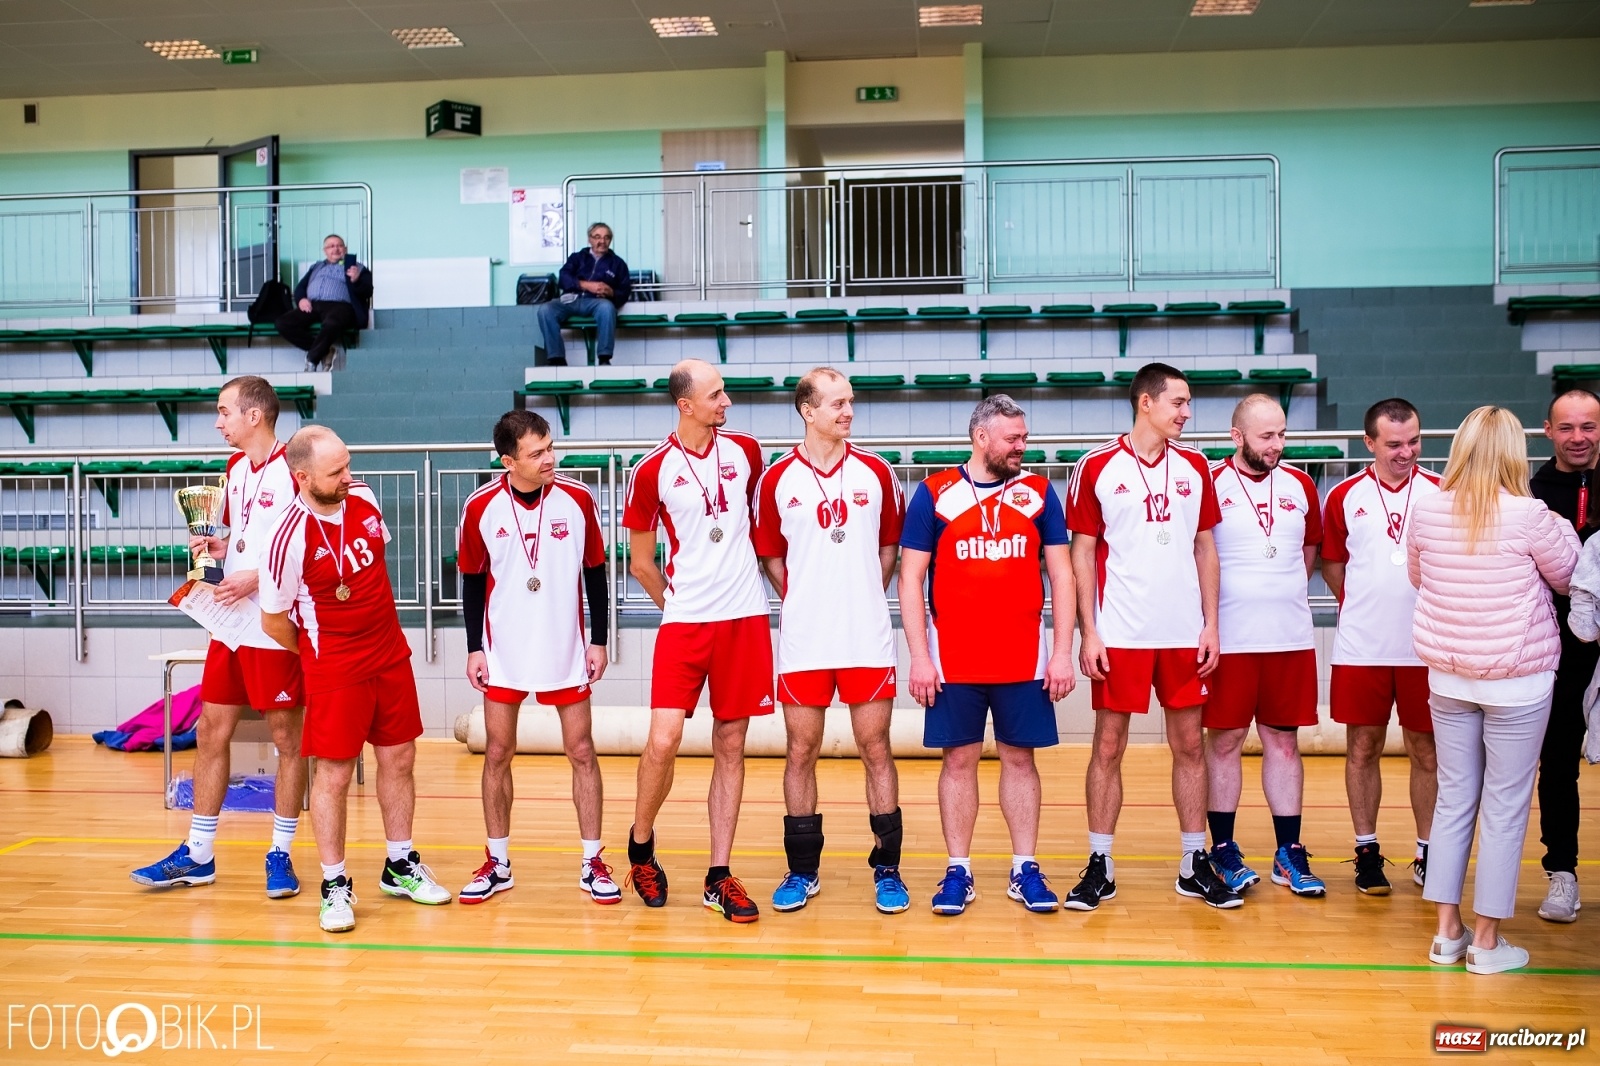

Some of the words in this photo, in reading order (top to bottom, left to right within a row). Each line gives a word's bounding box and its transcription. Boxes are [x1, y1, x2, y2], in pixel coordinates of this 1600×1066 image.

[430, 112, 439, 132] F
[454, 112, 471, 129] F
[702, 483, 729, 516] 14
[817, 498, 848, 529] 69
[1143, 494, 1171, 522] 12
[1256, 502, 1275, 529] 5
[1387, 512, 1402, 540] 8
[343, 537, 374, 574] 13
[524, 533, 539, 562] 7
[955, 533, 1027, 560] etisoft
